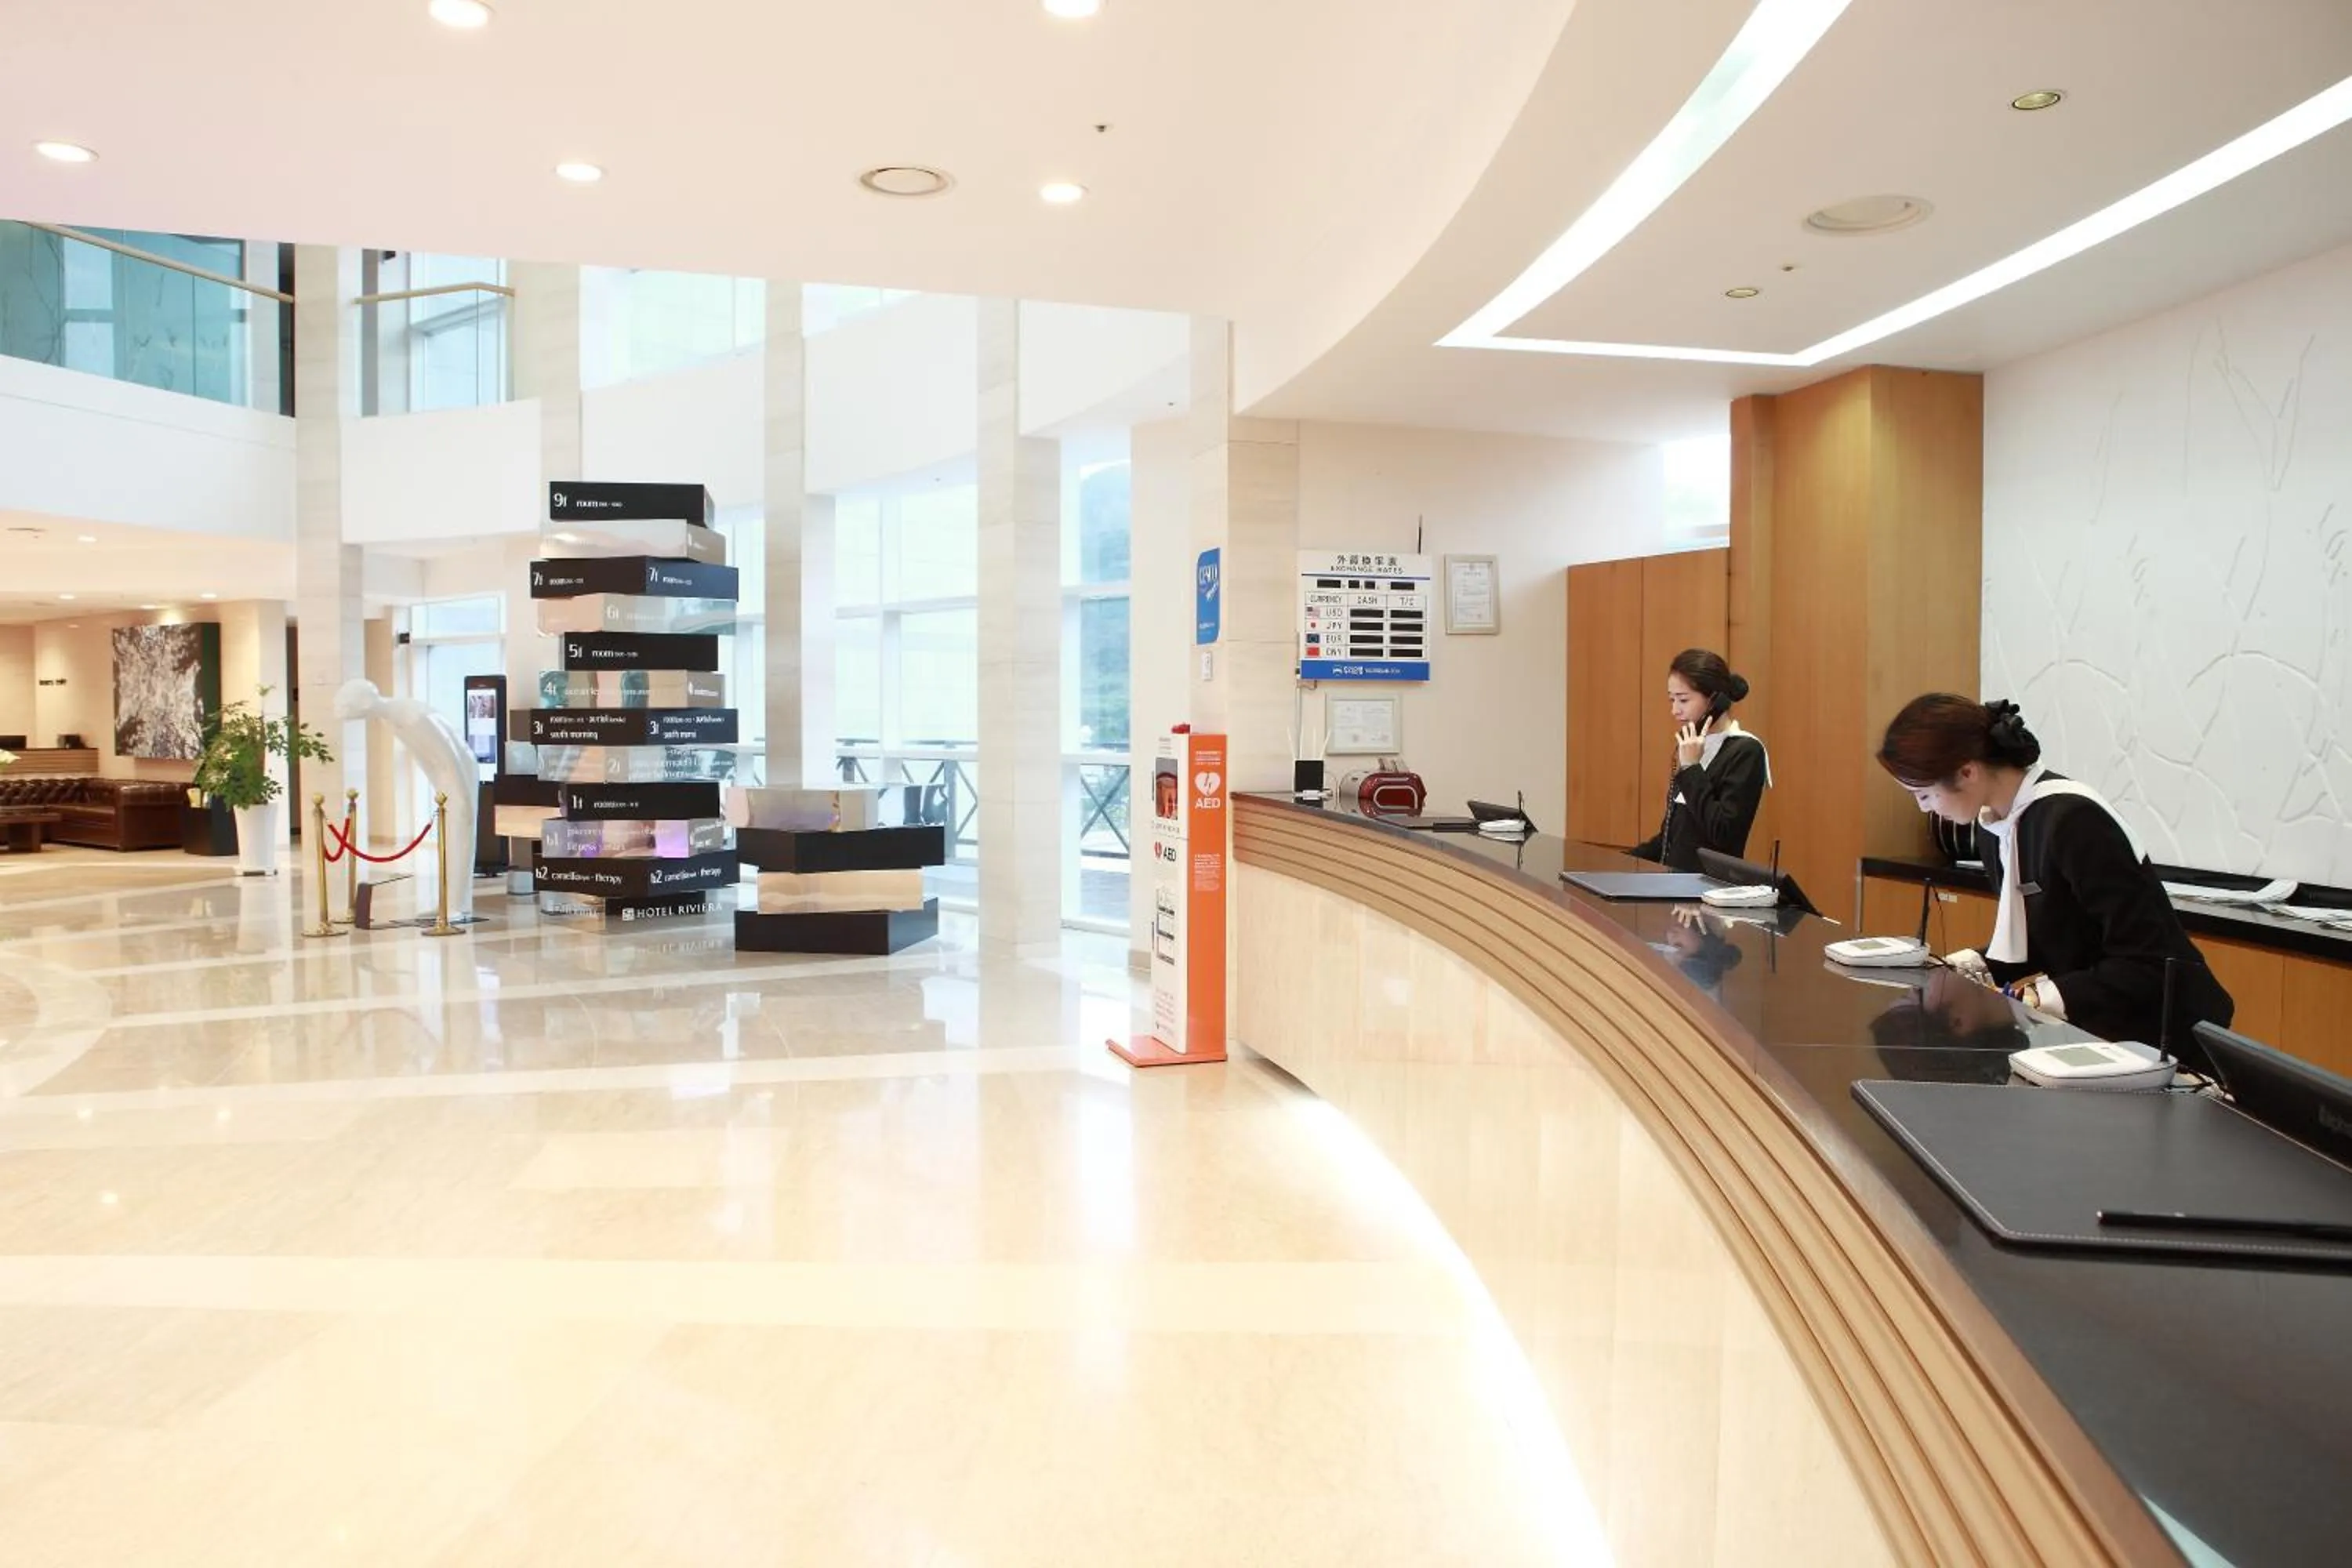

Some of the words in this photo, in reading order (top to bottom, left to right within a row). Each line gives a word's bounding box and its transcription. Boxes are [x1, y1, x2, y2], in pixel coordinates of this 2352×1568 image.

[1357, 597, 1377, 605] CASH
[1326, 608, 1343, 617] USD
[1195, 797, 1221, 809] AED
[1163, 846, 1177, 862] AED
[636, 906, 675, 919] HOTEL
[678, 902, 723, 914] RIVIERA
